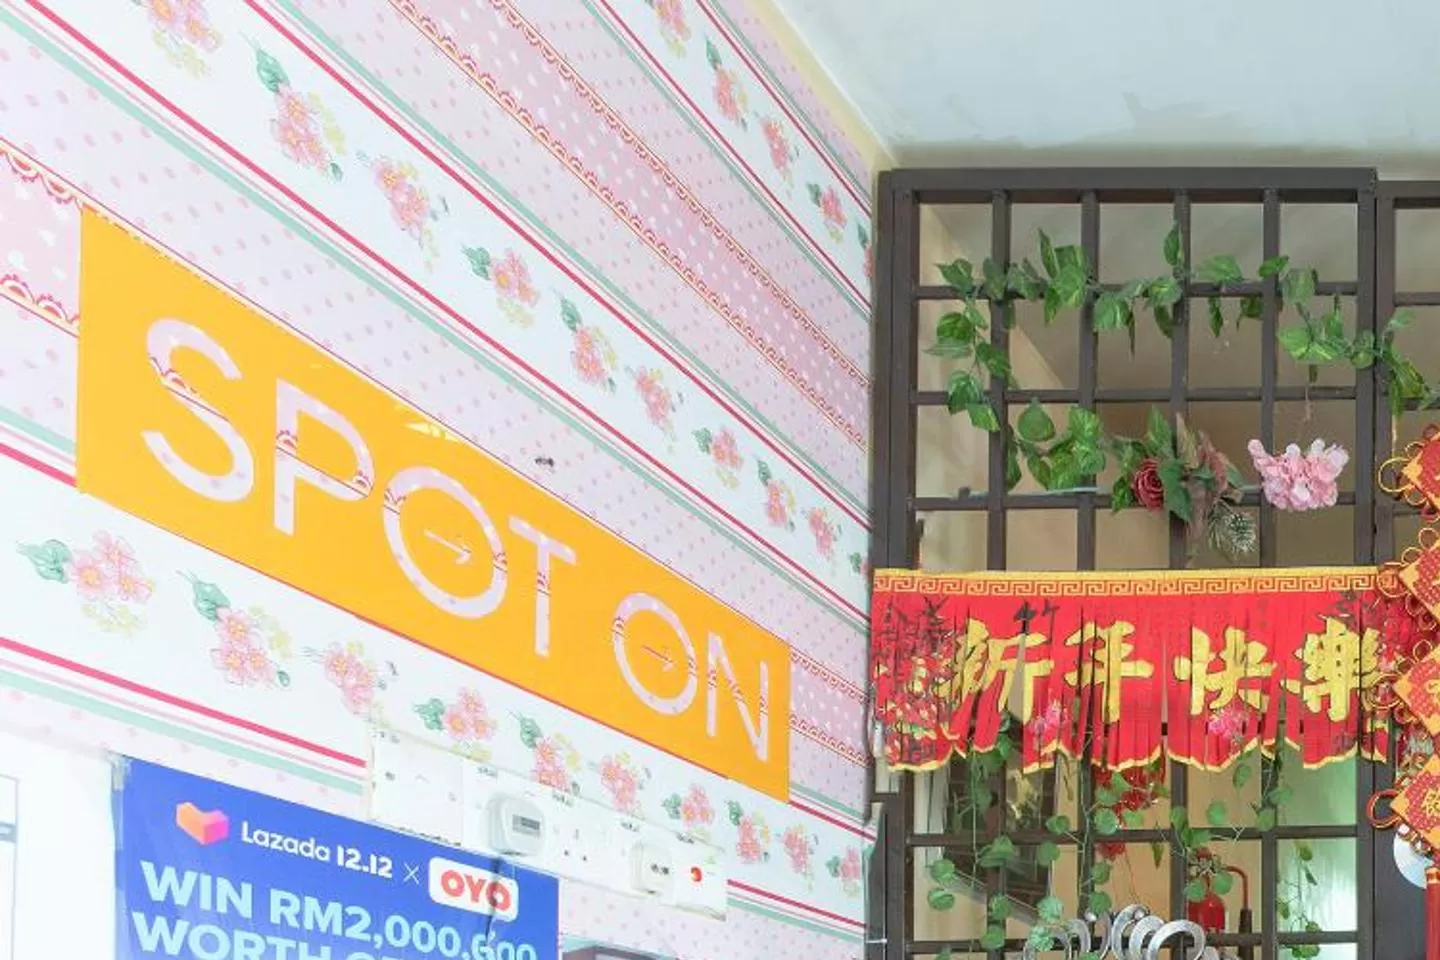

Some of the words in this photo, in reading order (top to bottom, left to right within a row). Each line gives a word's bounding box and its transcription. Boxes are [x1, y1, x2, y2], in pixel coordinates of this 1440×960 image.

[141, 318, 577, 658] SPOT
[612, 592, 768, 762] ON
[140, 860, 252, 918] WIN
[241, 821, 330, 861] Lazada
[337, 845, 393, 878] 12.12
[441, 870, 511, 911] OYO
